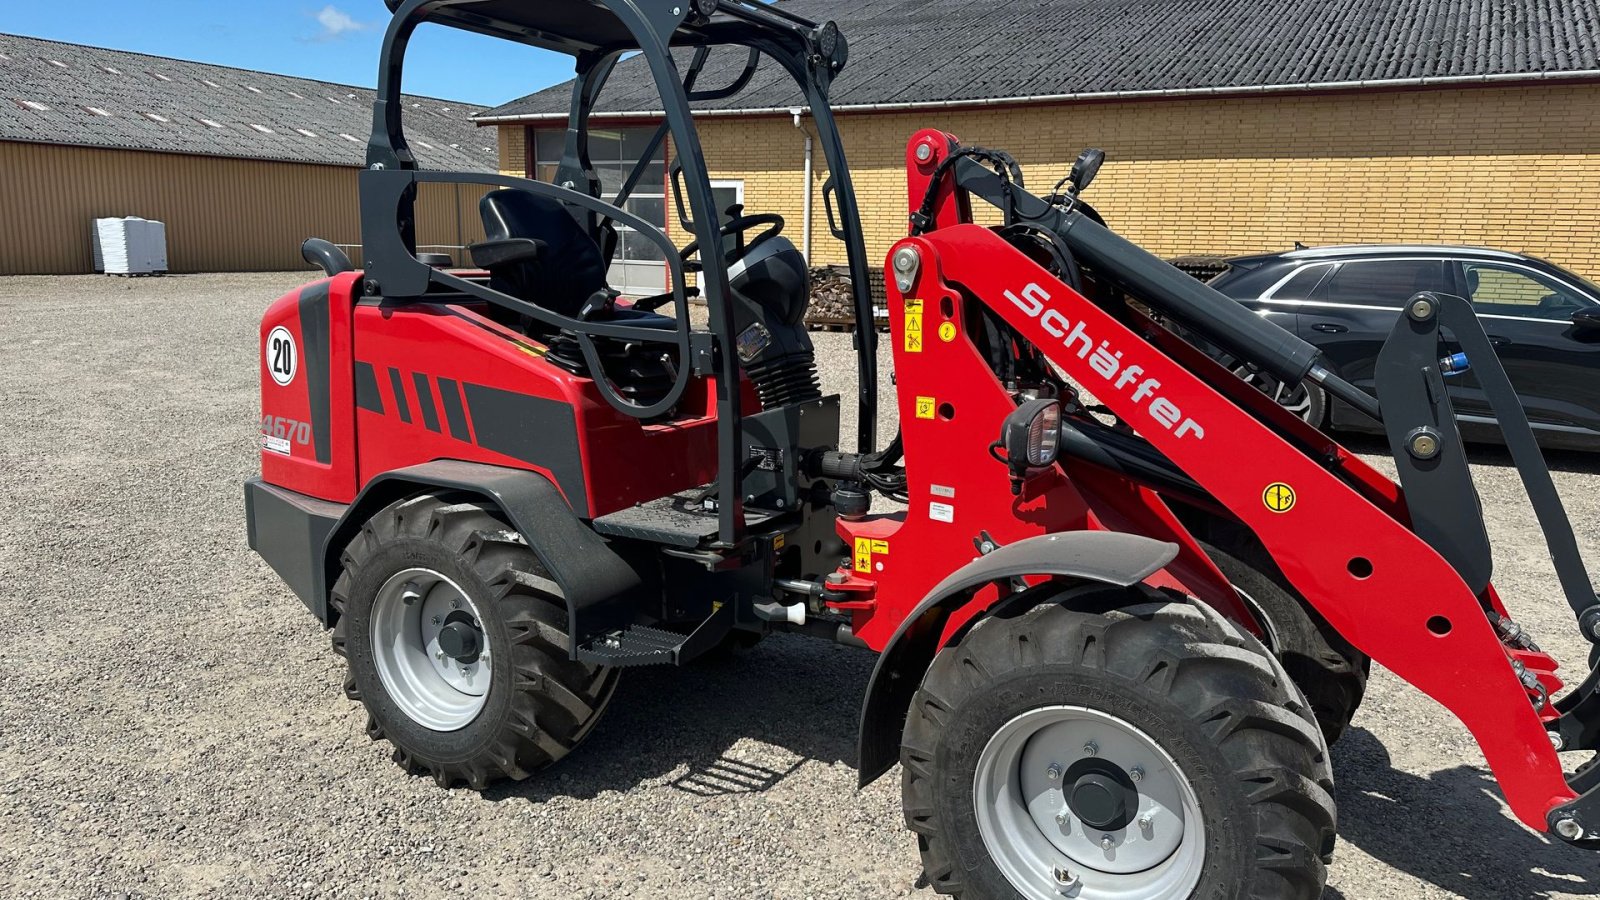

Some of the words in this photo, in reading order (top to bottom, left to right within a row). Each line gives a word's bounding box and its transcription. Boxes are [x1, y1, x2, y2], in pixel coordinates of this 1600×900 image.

[273, 337, 292, 375] 20
[1003, 283, 1205, 440] Schäffer
[261, 414, 311, 445] 4670
